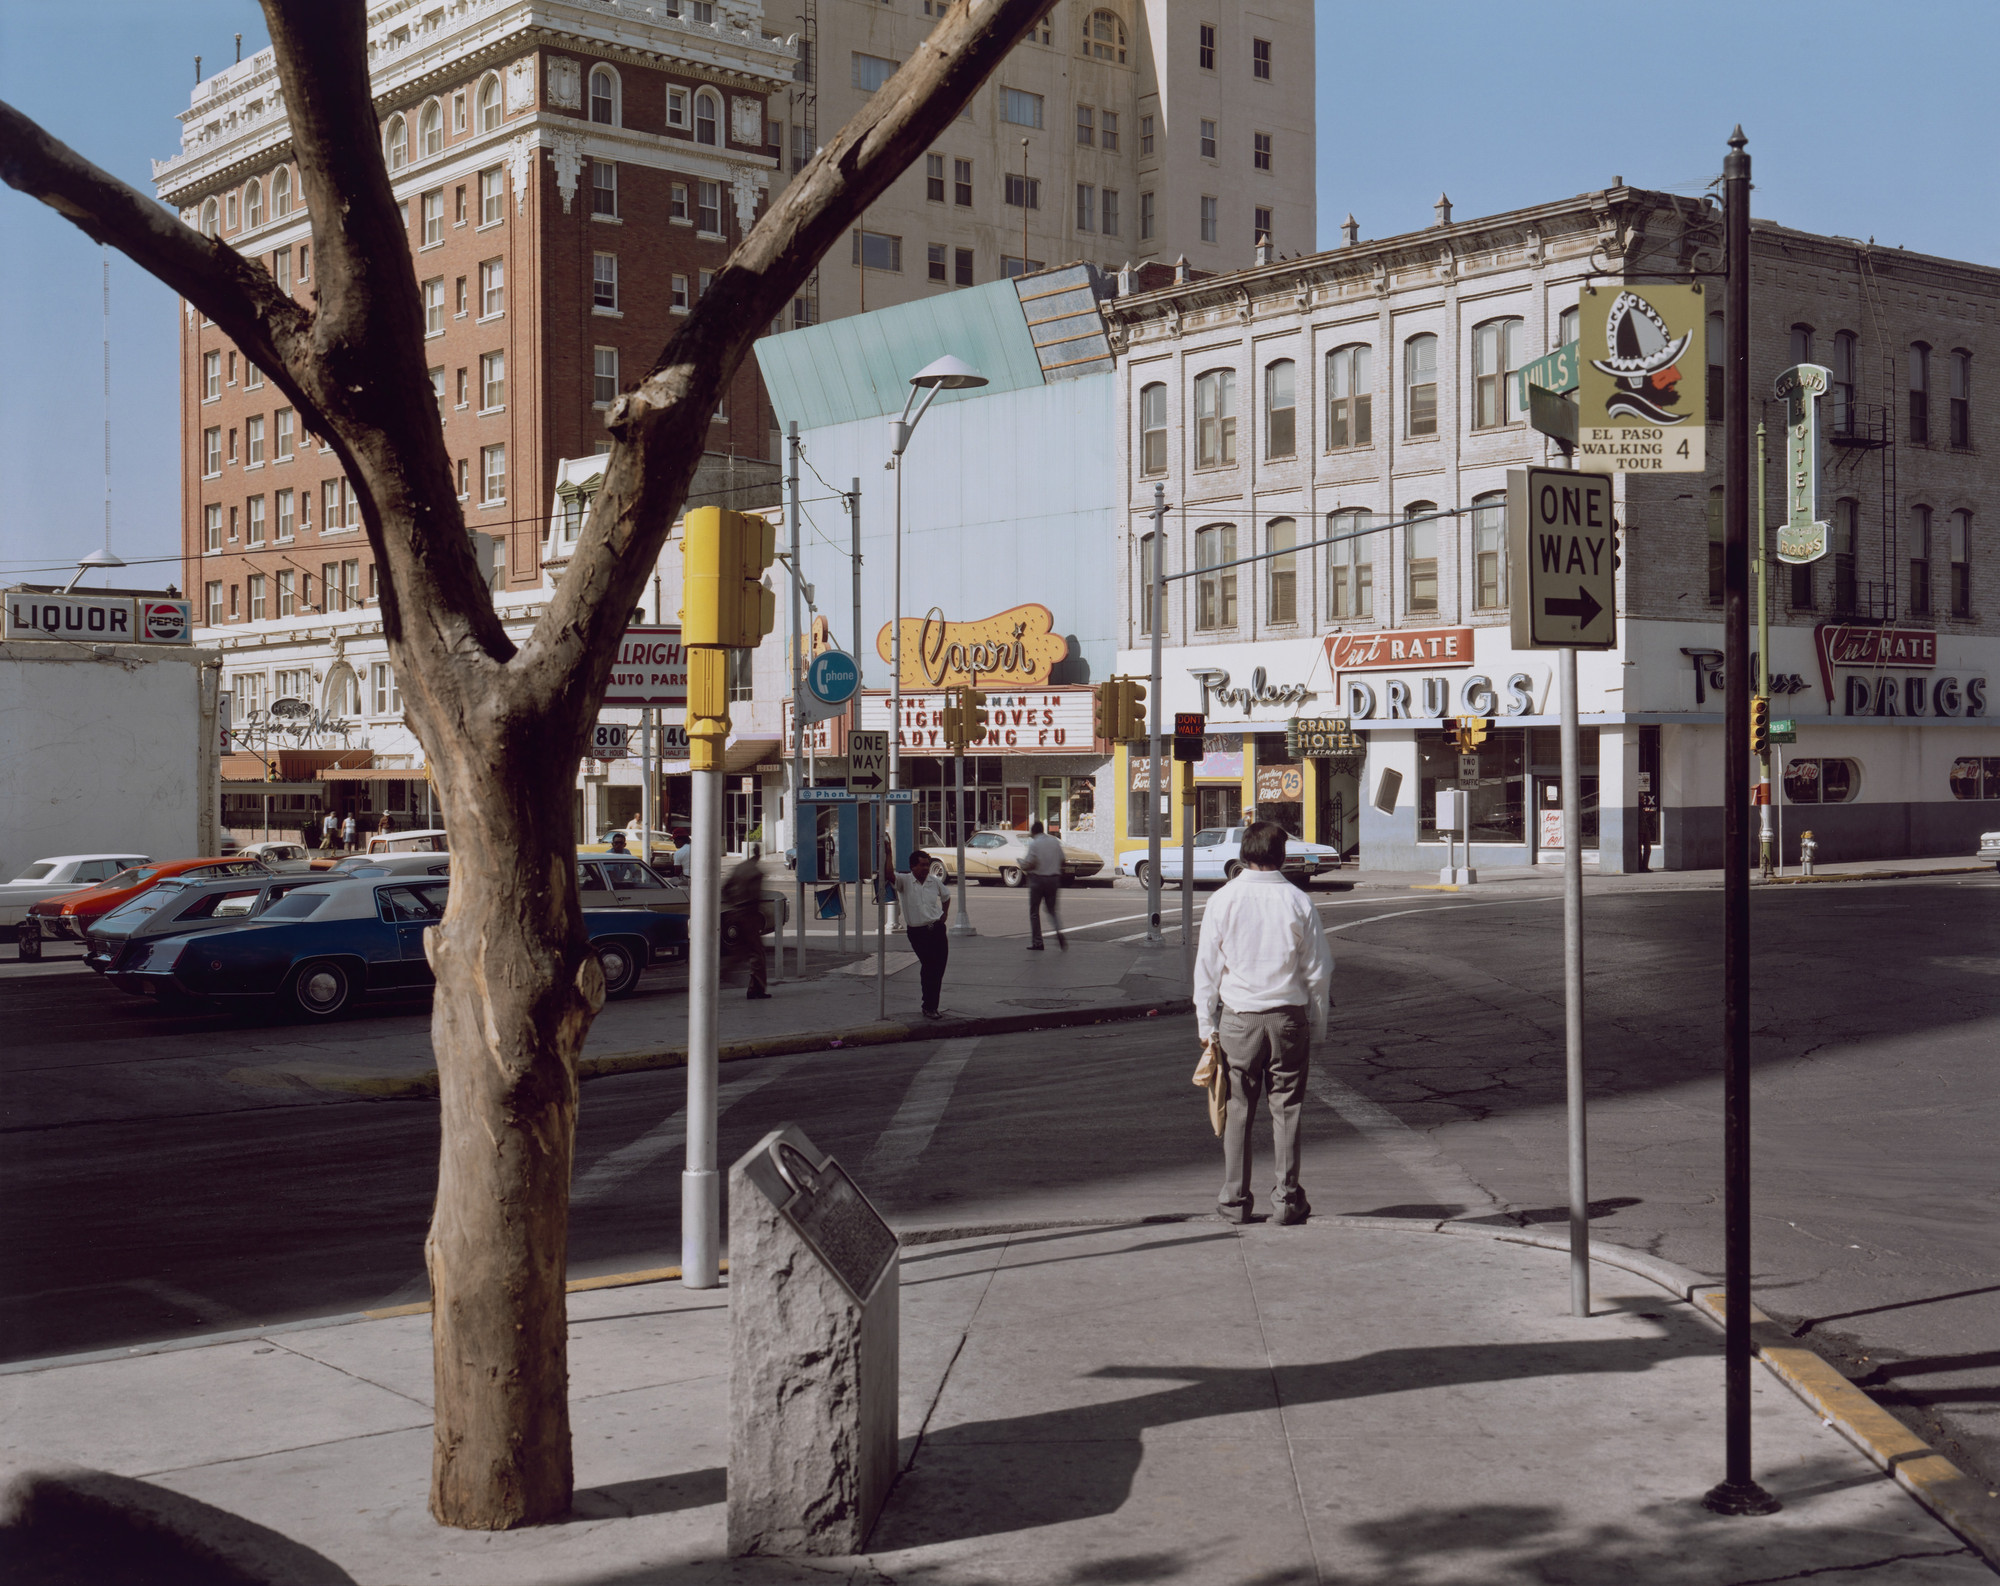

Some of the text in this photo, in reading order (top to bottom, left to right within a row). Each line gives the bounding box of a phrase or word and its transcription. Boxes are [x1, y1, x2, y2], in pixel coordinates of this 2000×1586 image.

[1776, 372, 1825, 397] GRAND
[1592, 429, 1663, 440] EL PASO
[1582, 438, 1690, 460] WALKING 4
[1795, 398, 1808, 513] HOTEL
[1616, 458, 1663, 469] TOUR
[1540, 485, 1603, 528] ONE
[1539, 533, 1606, 575] WAY
[1781, 537, 1823, 557] ROOMS
[13, 604, 127, 632] LIQUOR
[148, 616, 184, 627] PEPSI
[918, 606, 1034, 687] Capri
[1329, 629, 1459, 669] Cut RATE
[1829, 622, 1933, 662] Cut RATE
[607, 673, 644, 686] AUTO
[825, 670, 854, 683] phone
[1043, 695, 1061, 706] IN
[1187, 666, 1532, 720] Payless DRUGS
[1846, 675, 1987, 718] DRUGS
[1177, 715, 1202, 724] DONT
[1297, 719, 1347, 732] GRAND
[1038, 728, 1067, 746] FU
[1177, 725, 1202, 735] WALK
[853, 736, 883, 750] ONE
[1297, 733, 1361, 749] HOTEL
[852, 755, 884, 769] WAY
[1462, 758, 1476, 766] TWO
[1283, 772, 1299, 789] 25
